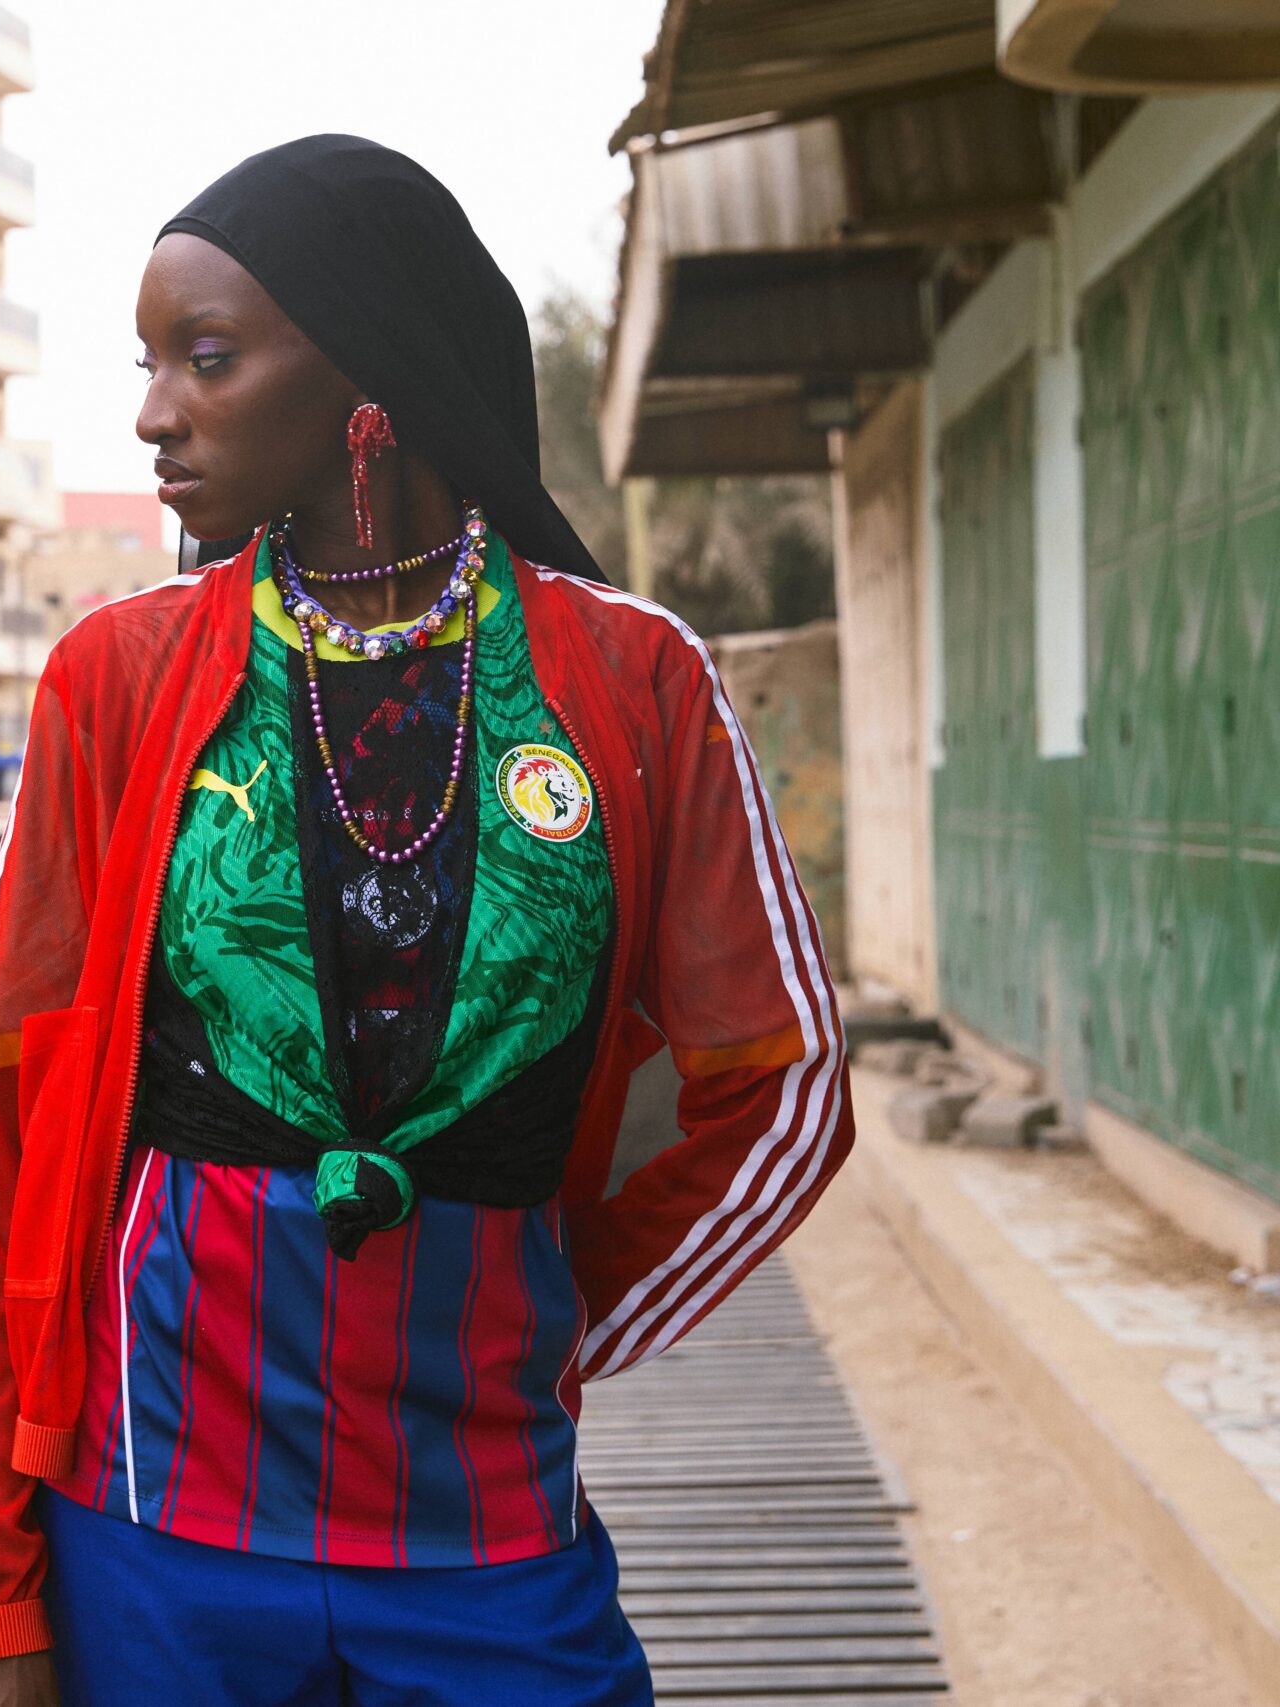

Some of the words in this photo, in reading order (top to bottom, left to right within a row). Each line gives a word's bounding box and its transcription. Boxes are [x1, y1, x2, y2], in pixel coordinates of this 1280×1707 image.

[525, 748, 585, 789] SÉNÉGALAISE
[580, 806, 587, 819] DE
[539, 820, 582, 837] FOOTBALL
